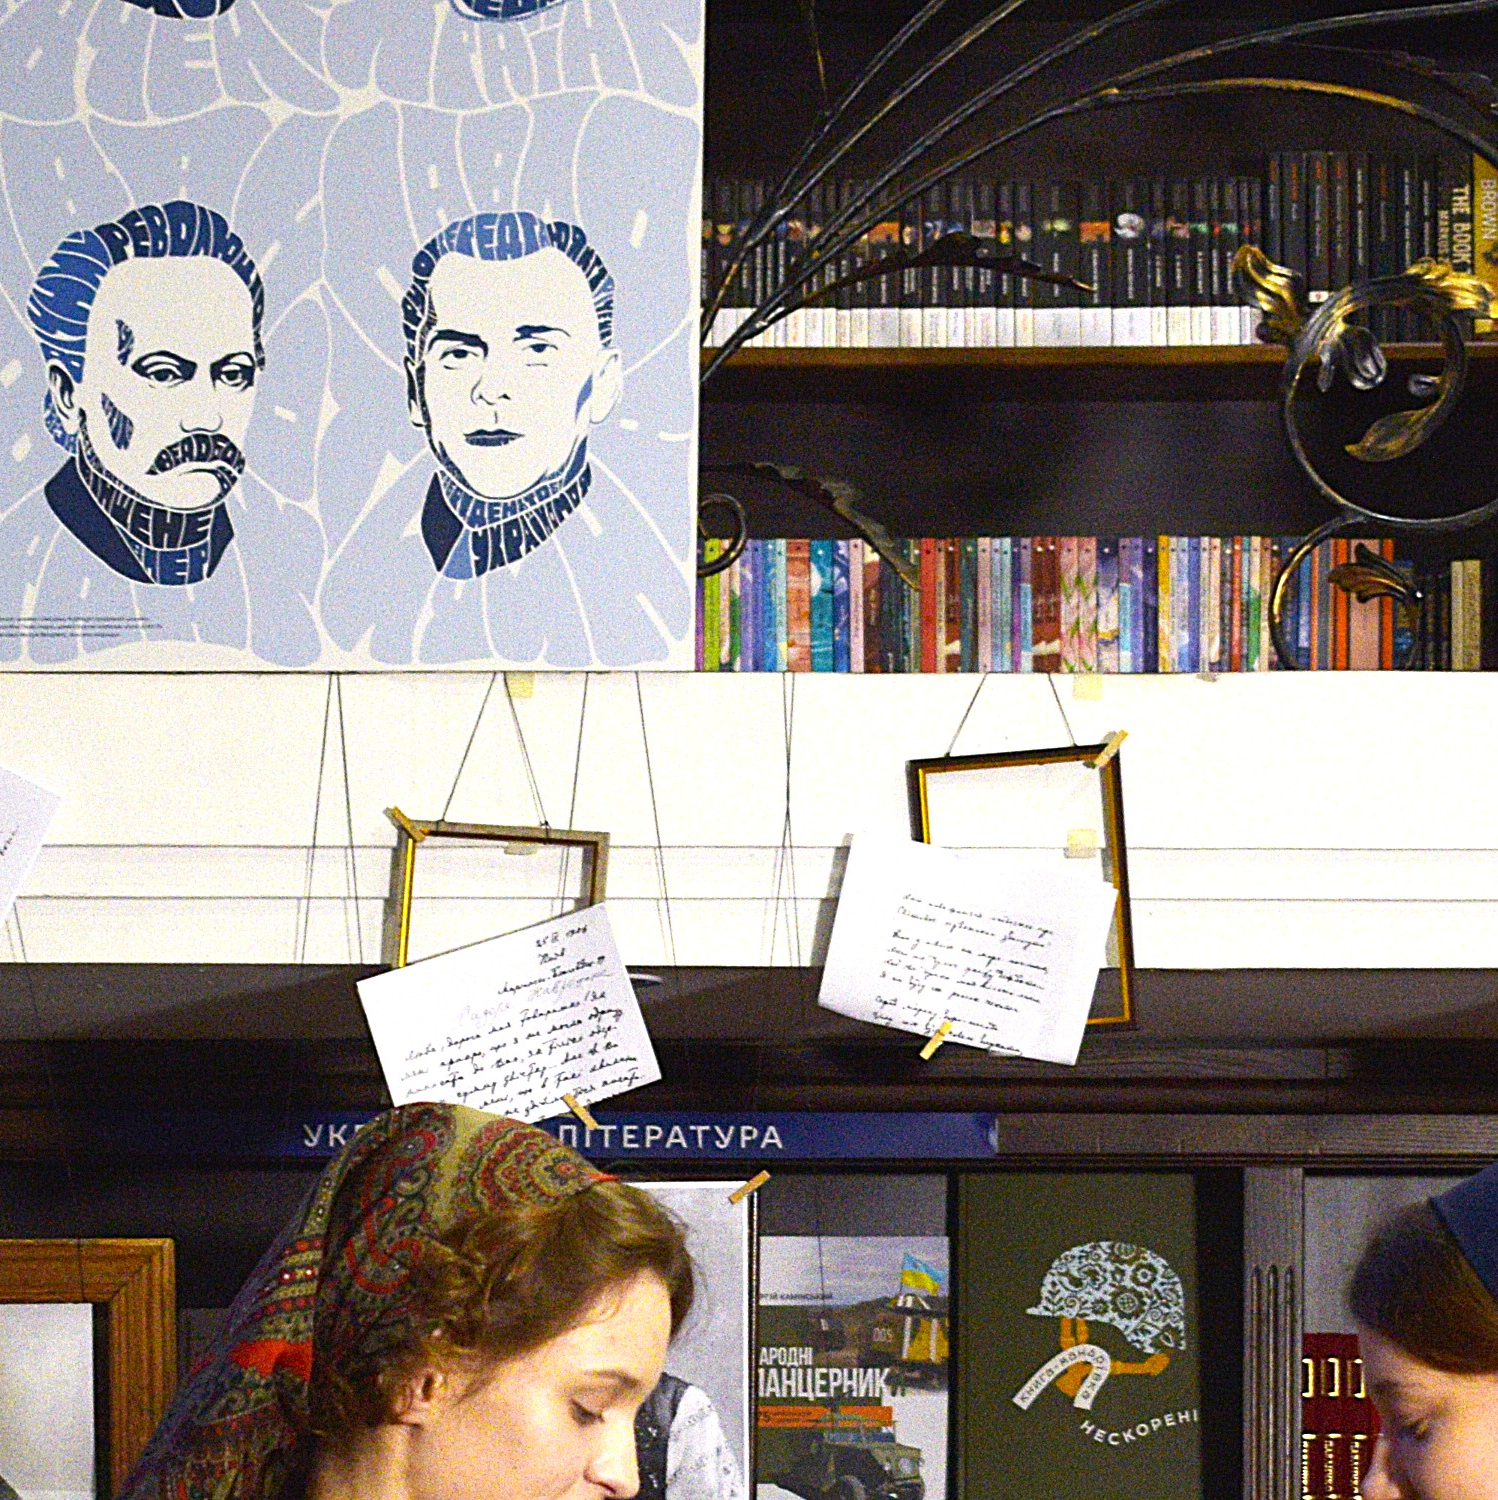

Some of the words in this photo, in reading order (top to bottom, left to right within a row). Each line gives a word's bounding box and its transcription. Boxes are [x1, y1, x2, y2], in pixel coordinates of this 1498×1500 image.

[1451, 183, 1470, 216] THE
[1480, 178, 1497, 241] BROWN
[1451, 222, 1470, 265] BOOK
[557, 1122, 785, 1151] ЛІТЕРАТУРА
[758, 1347, 814, 1367] АРОДНІ
[1078, 1407, 1202, 1447] НЕСКОРЕНІ
